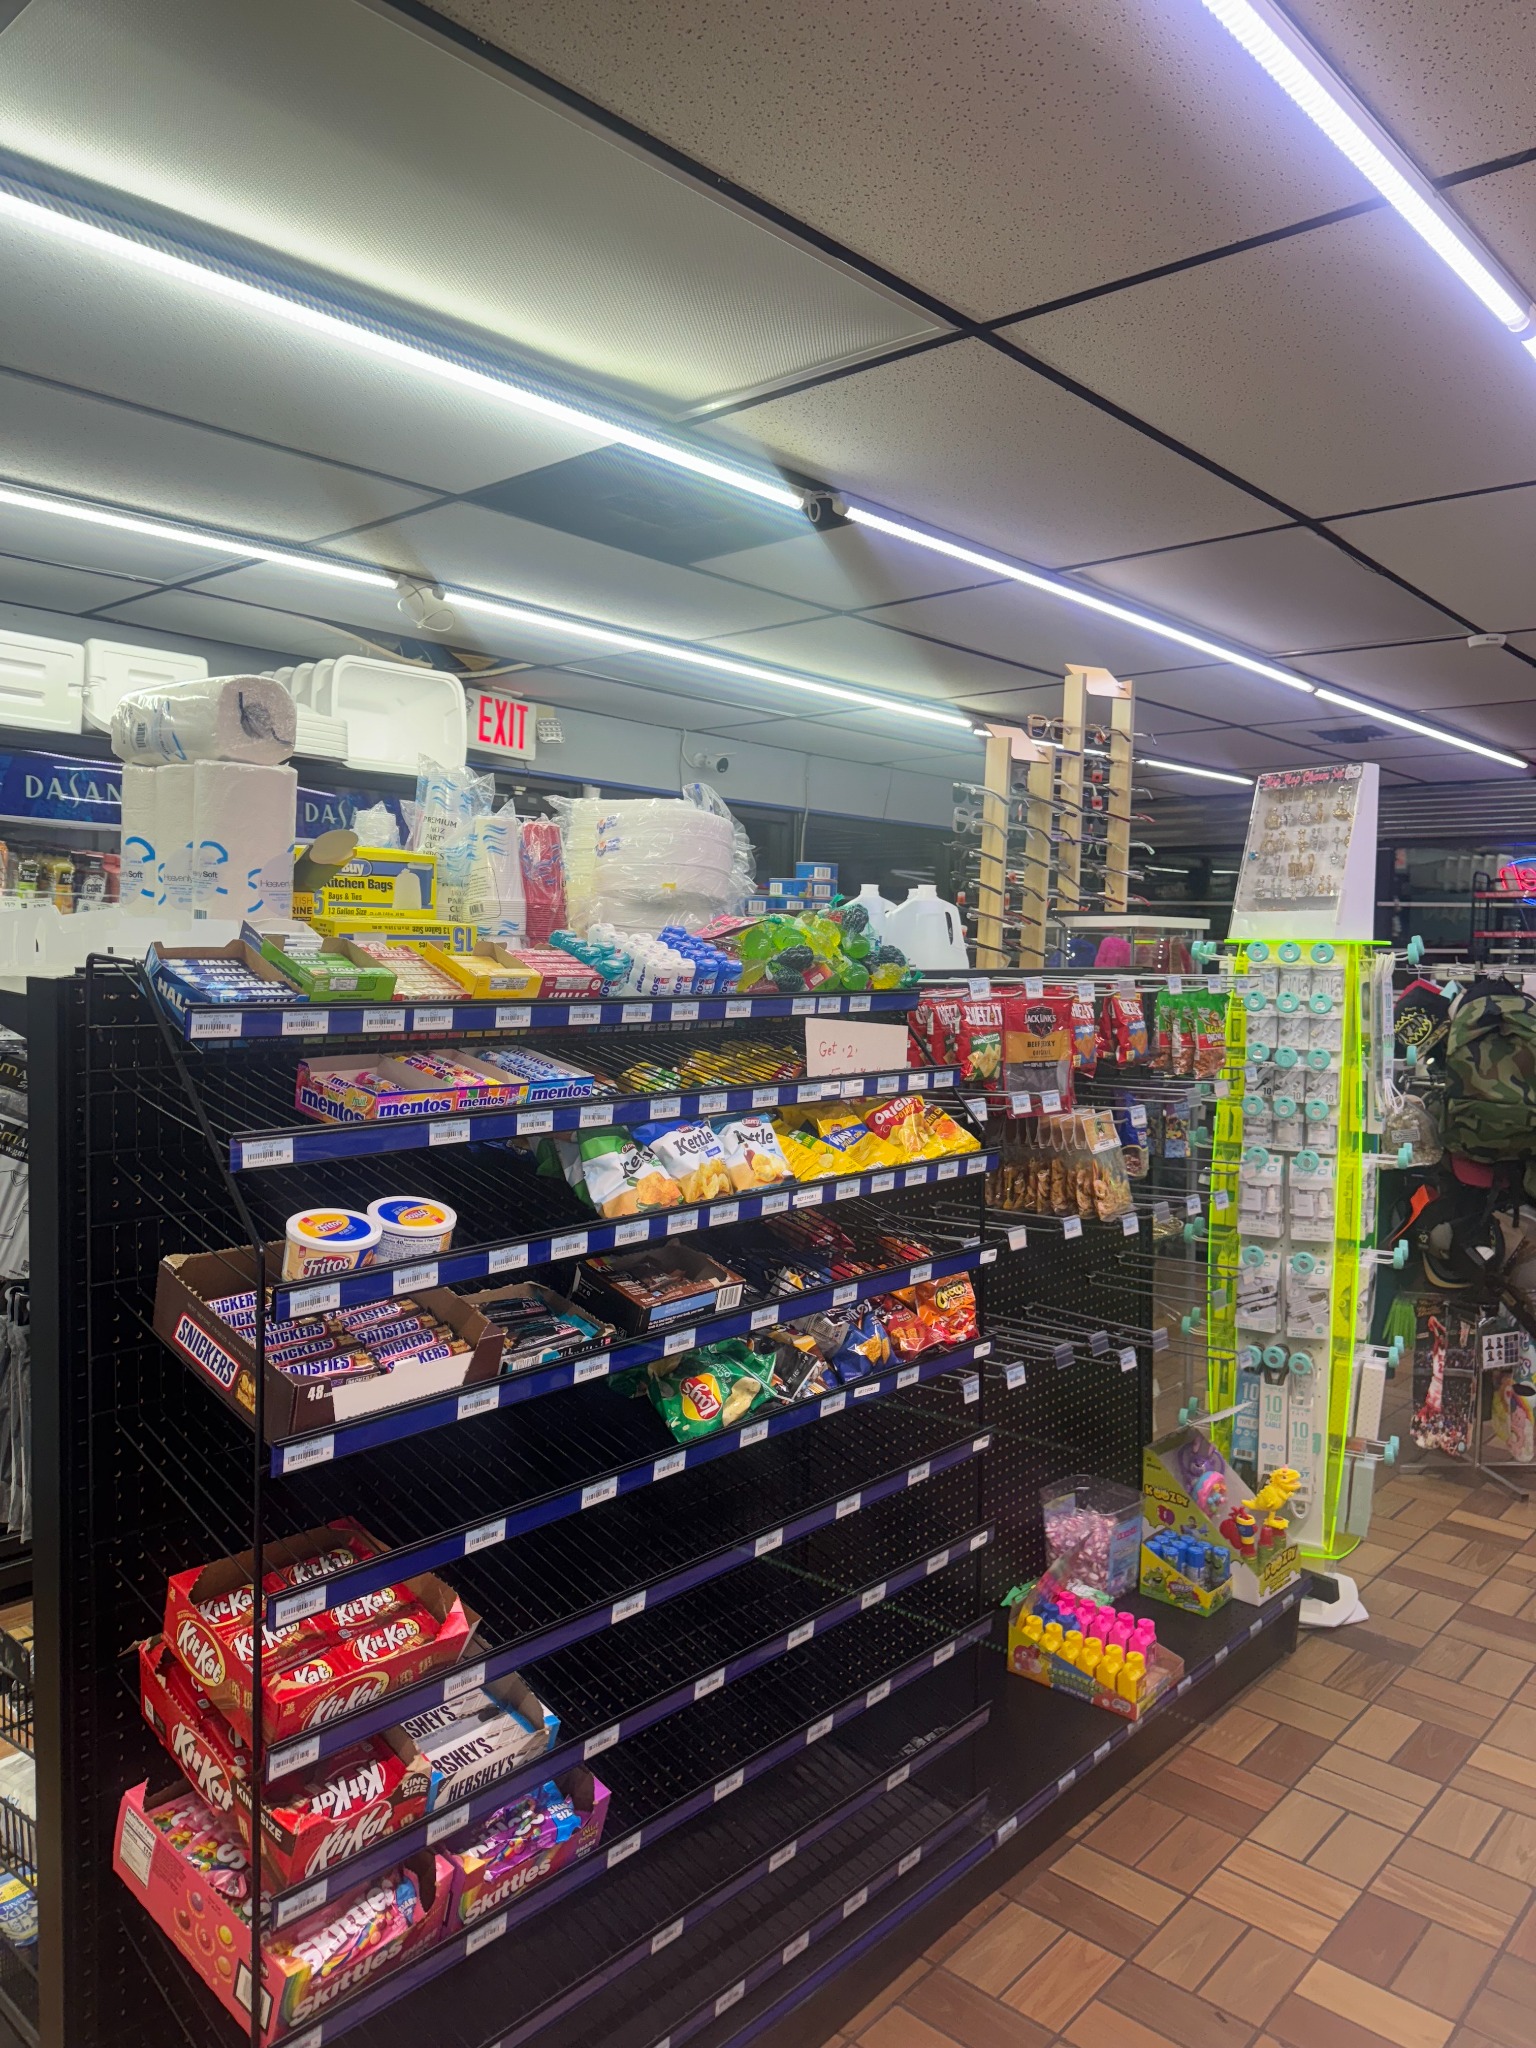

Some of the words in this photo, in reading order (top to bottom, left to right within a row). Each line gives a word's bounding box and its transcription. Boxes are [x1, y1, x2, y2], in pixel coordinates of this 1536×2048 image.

[478, 696, 530, 750] EXIT
[129, 871, 143, 879] Soft
[87, 884, 102, 893] CORE
[368, 879, 393, 893] Bags
[328, 892, 343, 901] Bags
[351, 893, 362, 901] Ties
[328, 907, 336, 915] 13
[412, 927, 424, 935] Size
[425, 927, 441, 935] Gallon
[441, 927, 450, 935] 13
[453, 926, 474, 952] 15
[198, 959, 241, 967] HALLS
[213, 974, 258, 982] HALLS
[238, 981, 284, 989] HALLS
[1024, 1014, 1040, 1024] JACK
[819, 1041, 837, 1058] Get
[531, 1084, 592, 1101] mentos
[1263, 1087, 1272, 1095] 10
[1293, 1092, 1301, 1100] 10
[1325, 1094, 1334, 1102] 10
[301, 1087, 366, 1121] mentos
[352, 1097, 367, 1108] fruit
[379, 1098, 451, 1118] mentos
[459, 1095, 505, 1108] mentos
[673, 1130, 715, 1157] Kettle
[315, 1219, 343, 1232] Fritos
[303, 1257, 350, 1277] Fritos
[342, 1303, 399, 1328] SATISFIES
[357, 1319, 419, 1345] SATISFIES
[178, 1319, 235, 1385] SNICKERS
[372, 1329, 433, 1360] SNICKERS
[282, 1356, 350, 1376] ATISFIES
[387, 1344, 449, 1371] SKERS
[307, 1385, 324, 1401] 48
[682, 1382, 721, 1418] Lay's
[1243, 1382, 1259, 1400] 10
[1265, 1395, 1282, 1412] 10
[1264, 1421, 1282, 1429] CABLE
[1265, 1413, 1282, 1421] FOOT
[1292, 1422, 1309, 1439] 10
[293, 1552, 352, 1584] KitKat
[335, 1590, 395, 1627] KitKat
[178, 1620, 222, 1684] KitKat
[357, 1623, 419, 1664] KitKat
[308, 1680, 384, 1729] KitKat
[405, 1705, 457, 1739] SHEY'S
[432, 1737, 494, 1775] RSHEY'S
[173, 1721, 234, 1812] KitKat
[402, 1777, 429, 1789] KING
[449, 1753, 515, 1802] HERSHEY'S
[310, 1759, 384, 1818] KitKat
[403, 1785, 428, 1798] SIZE
[260, 1812, 283, 1843] SIZE
[305, 1806, 393, 1879] KitKat
[463, 1858, 551, 1926] Skittles
[289, 1940, 403, 2027] Skittles
